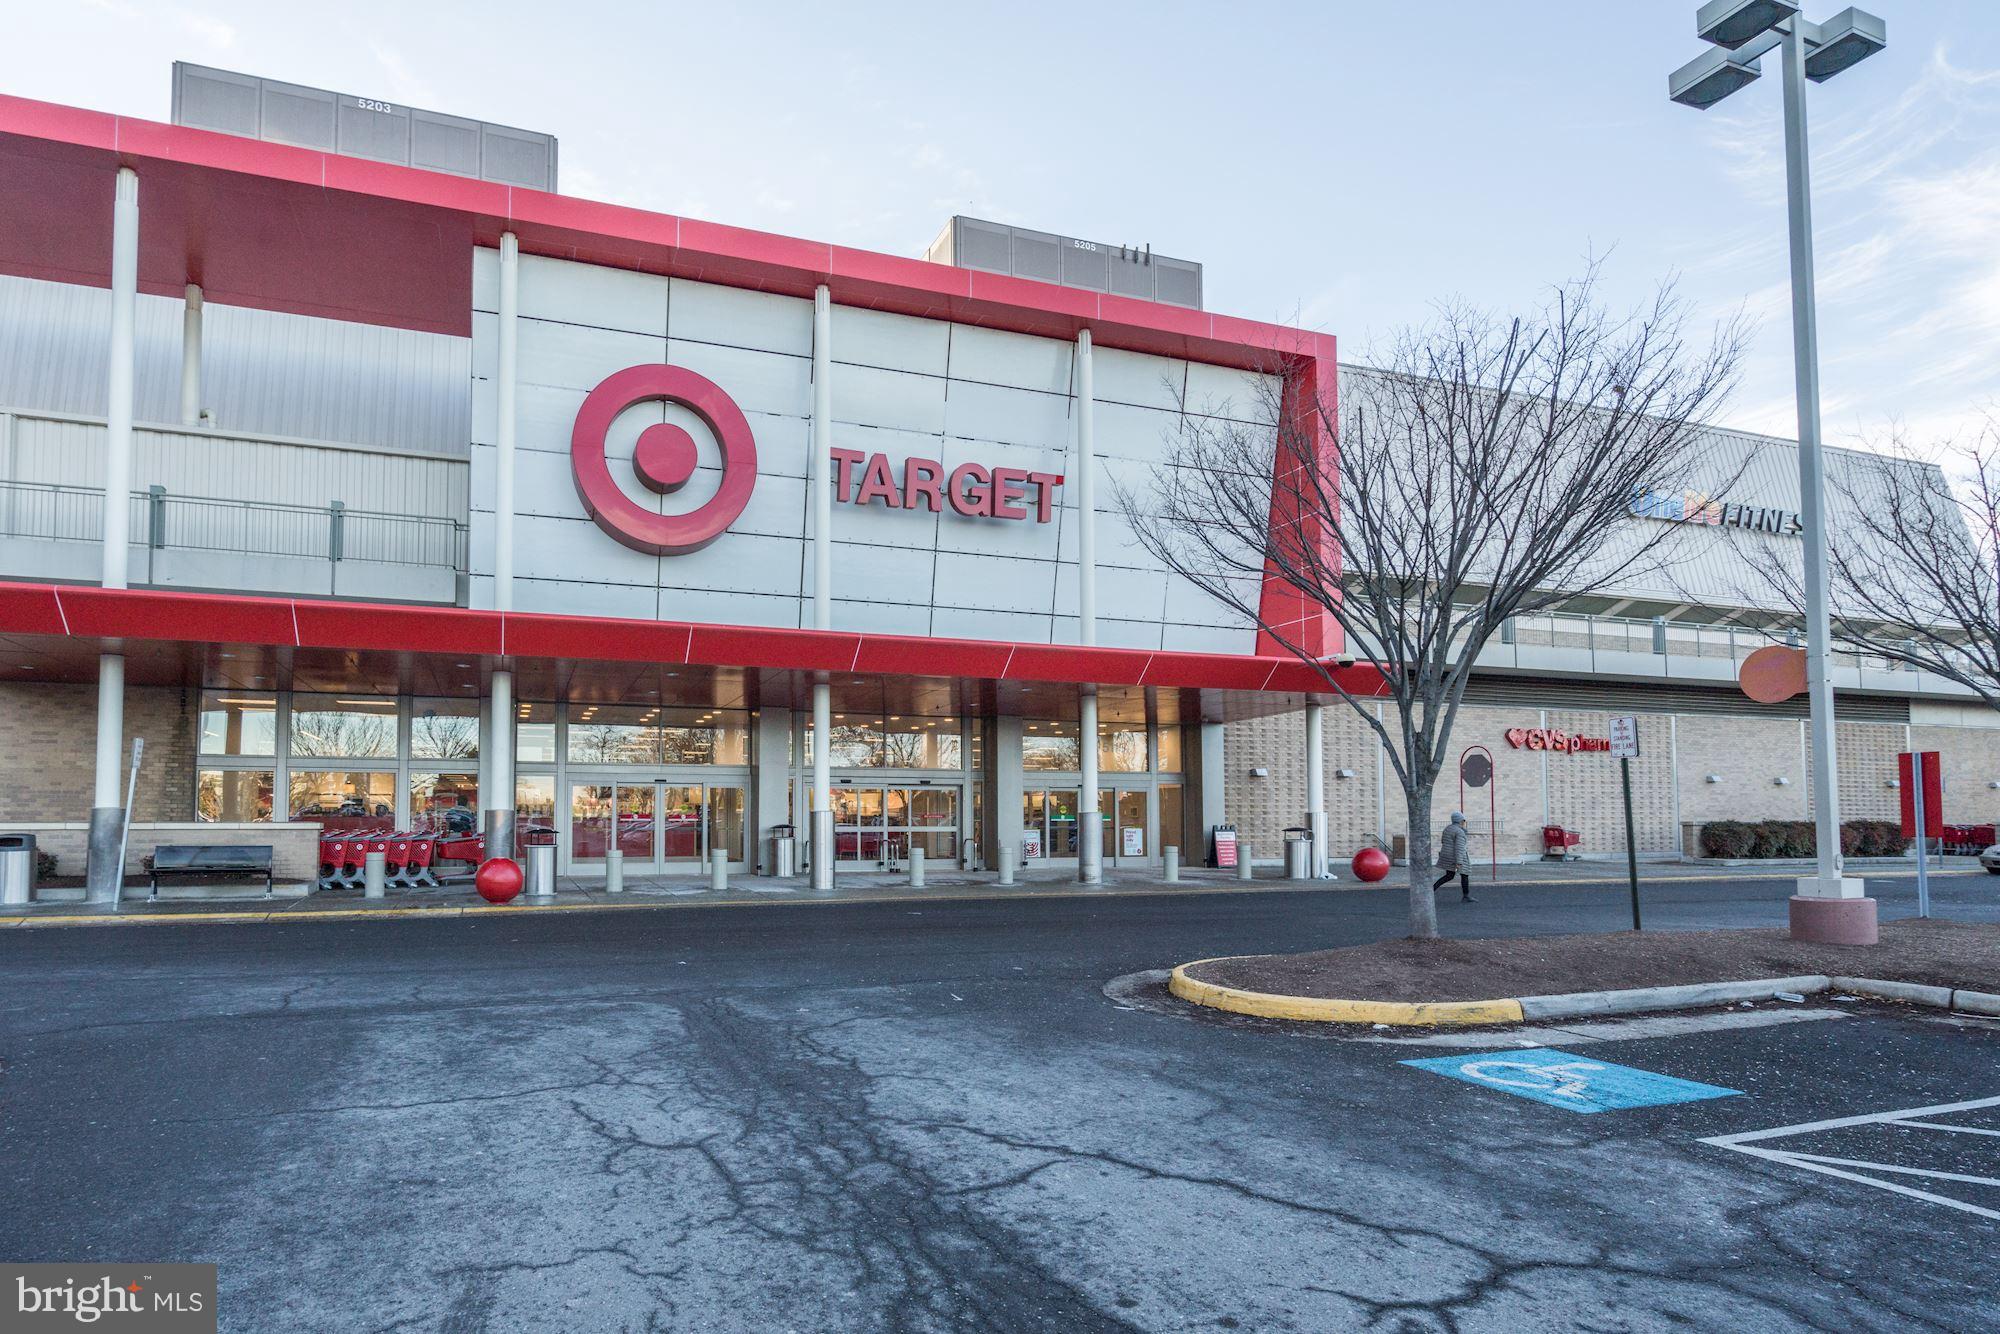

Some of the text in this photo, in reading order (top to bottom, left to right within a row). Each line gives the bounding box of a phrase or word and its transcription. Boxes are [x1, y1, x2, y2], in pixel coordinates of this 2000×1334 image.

[358, 98, 391, 113] 5203
[1074, 240, 1096, 251] 5205
[830, 446, 1064, 523] TARGET
[1525, 728, 1568, 751] CVS
